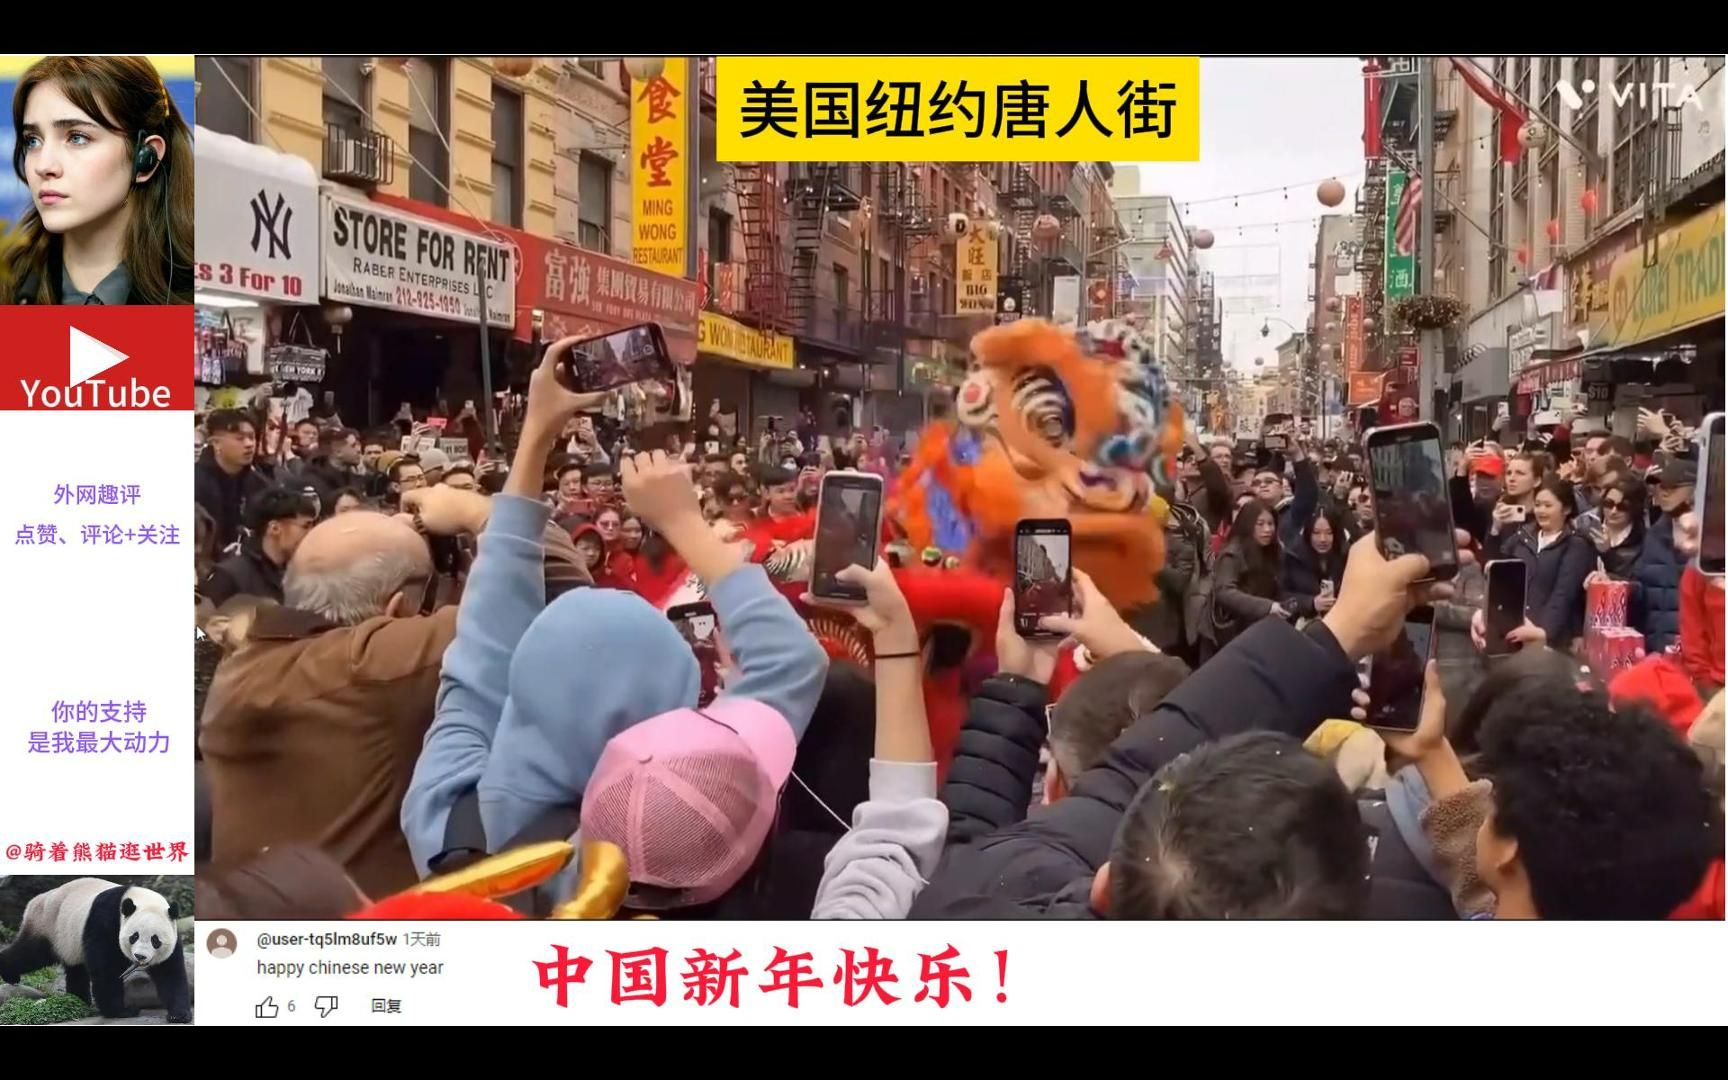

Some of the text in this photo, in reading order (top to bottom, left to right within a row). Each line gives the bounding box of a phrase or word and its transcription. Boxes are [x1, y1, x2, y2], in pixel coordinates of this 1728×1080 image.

[637, 75, 681, 188] 食堂
[250, 189, 293, 260] NY
[643, 200, 673, 216] MING
[333, 206, 510, 282] STORE FOR RENT
[639, 223, 676, 240] WONG
[633, 247, 683, 264] RESTAURANT
[219, 263, 233, 285] 3
[239, 267, 275, 292] For
[282, 275, 302, 297] 10
[353, 257, 493, 299] RABER ENTERPRISES LC
[545, 248, 591, 306] 富強
[966, 284, 988, 296] BIG
